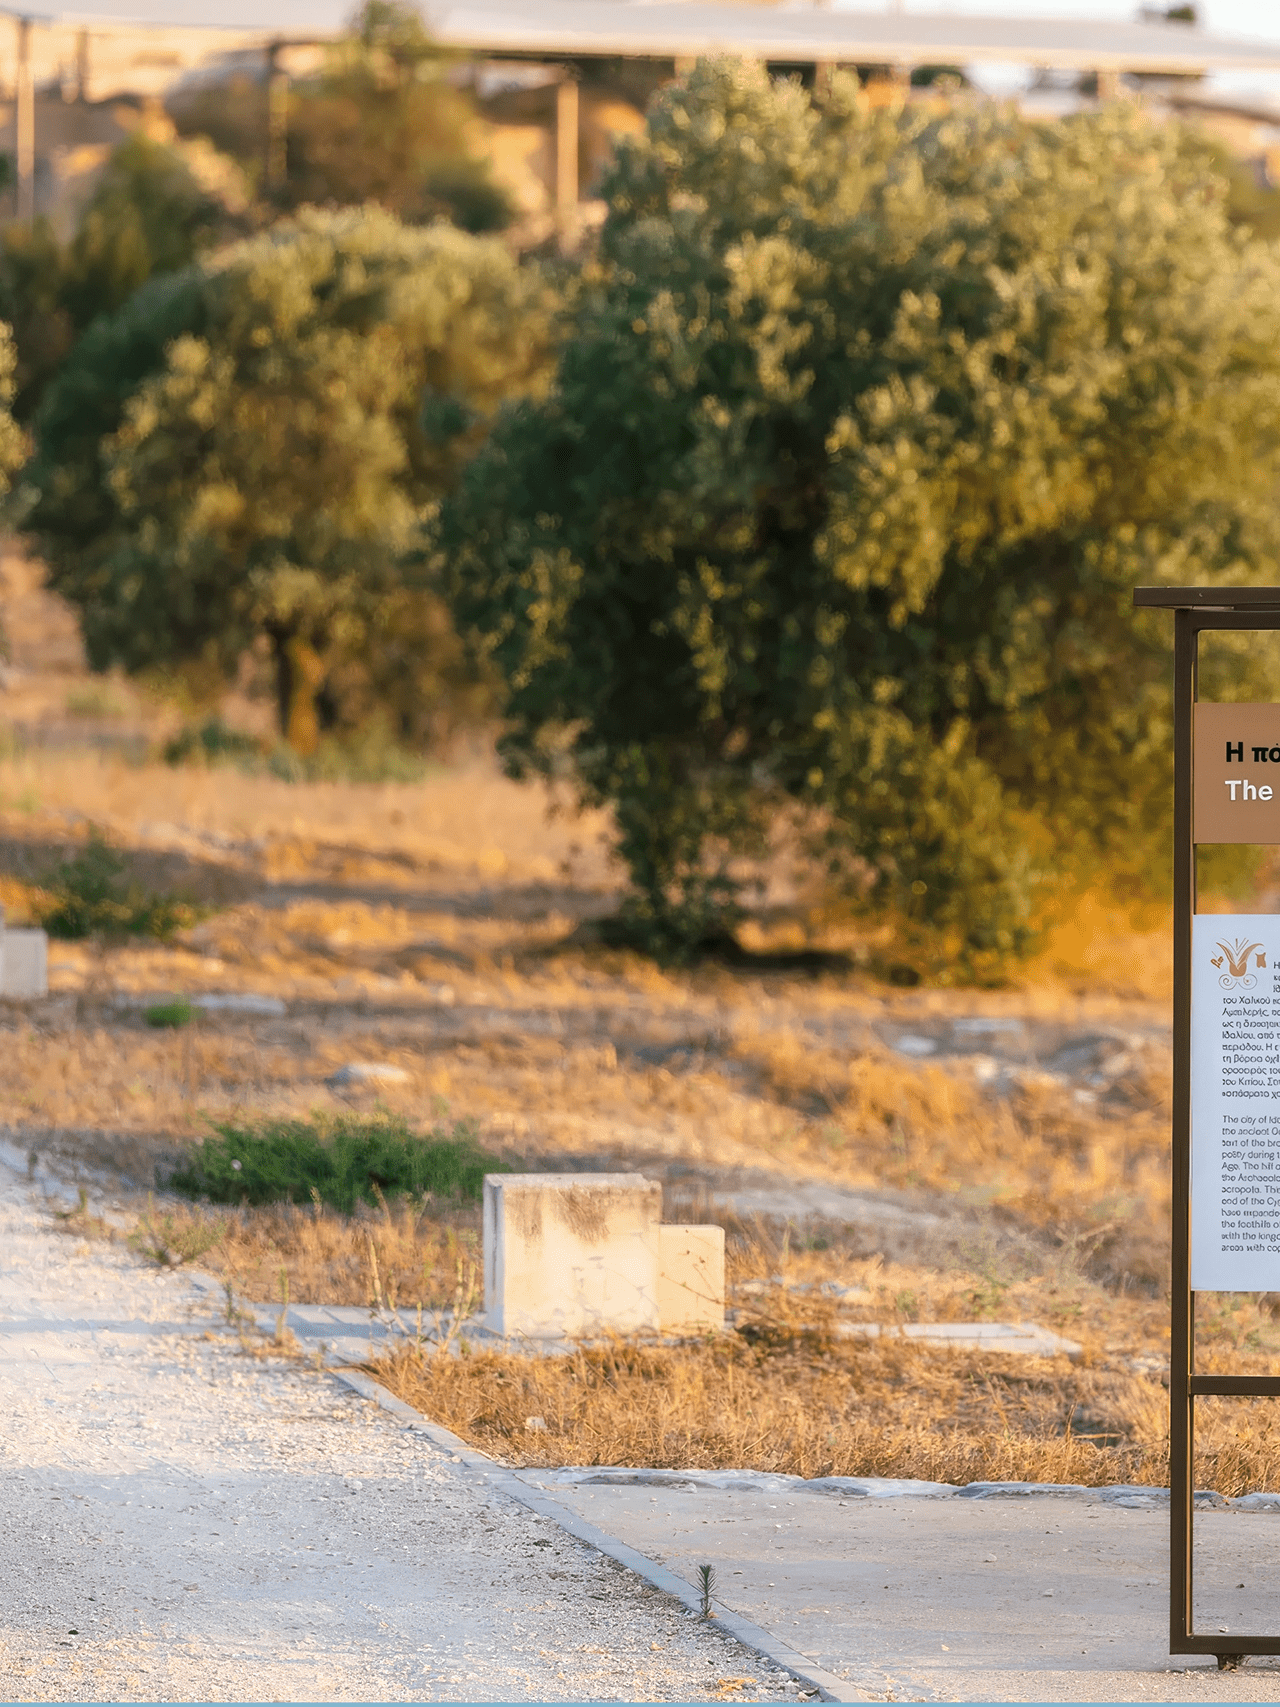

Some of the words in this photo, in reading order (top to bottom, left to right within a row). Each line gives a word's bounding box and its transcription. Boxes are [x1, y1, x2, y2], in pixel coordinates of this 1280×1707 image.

[1225, 741, 1244, 763] Η
[1224, 779, 1273, 801] The
[1223, 1115, 1238, 1123] The
[1258, 1115, 1267, 1123] of
[1222, 1127, 1236, 1135] the
[1240, 1139, 1248, 1147] of
[1251, 1138, 1265, 1146] the
[1243, 1161, 1259, 1169] The
[1222, 1173, 1236, 1181] the
[1240, 1197, 1248, 1205] of
[1221, 1220, 1235, 1228] the
[1243, 1231, 1256, 1239] the
